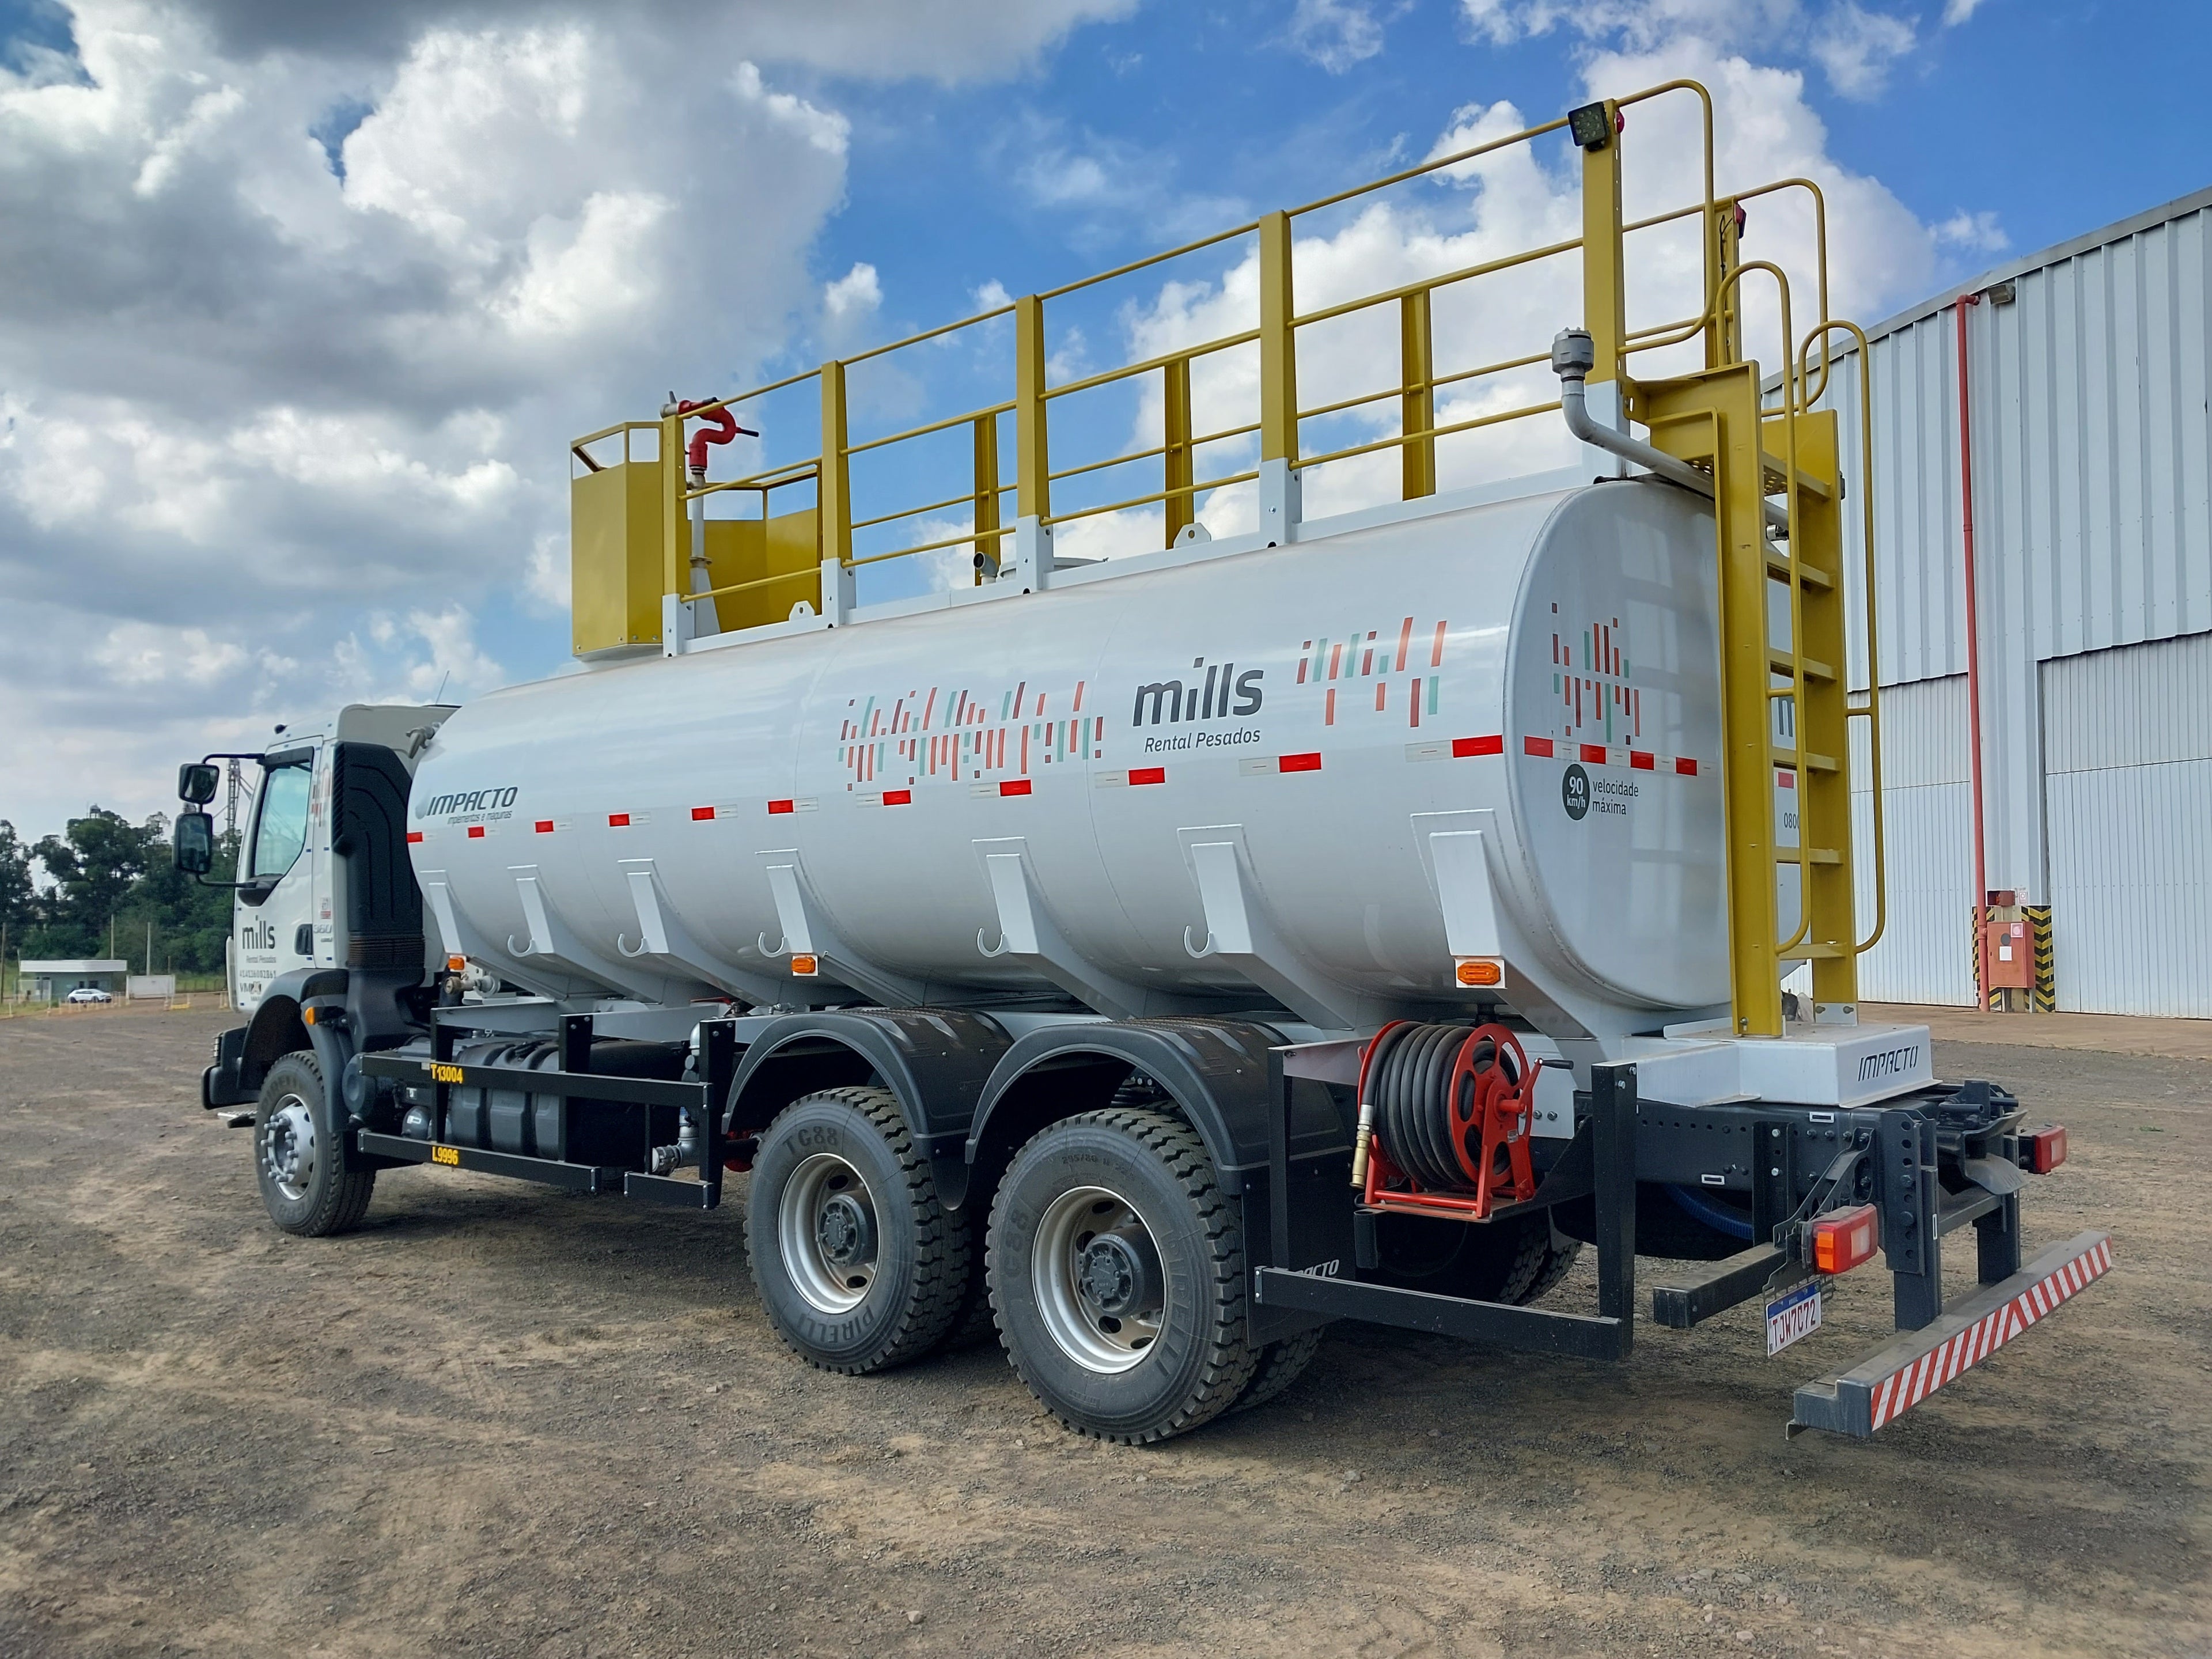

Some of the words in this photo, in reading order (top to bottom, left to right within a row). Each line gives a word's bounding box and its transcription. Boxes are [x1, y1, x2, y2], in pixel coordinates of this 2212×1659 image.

[1133, 657, 1264, 726] mills
[1145, 733, 1192, 753] Rental
[1195, 727, 1260, 748] Pesados
[1569, 776, 1584, 794] 90
[1593, 778, 1638, 797] velocidade
[426, 787, 518, 816] IMPACTO
[1567, 794, 1585, 809] km/h
[1593, 797, 1626, 815] máxima
[242, 915, 275, 949] mills
[431, 1064, 463, 1084] T13004
[1858, 1046, 1918, 1081] IMPACTO
[432, 1146, 459, 1165] L9996
[797, 1304, 874, 1343] PIRELLI
[1772, 1299, 1816, 1347] TJW7C72
